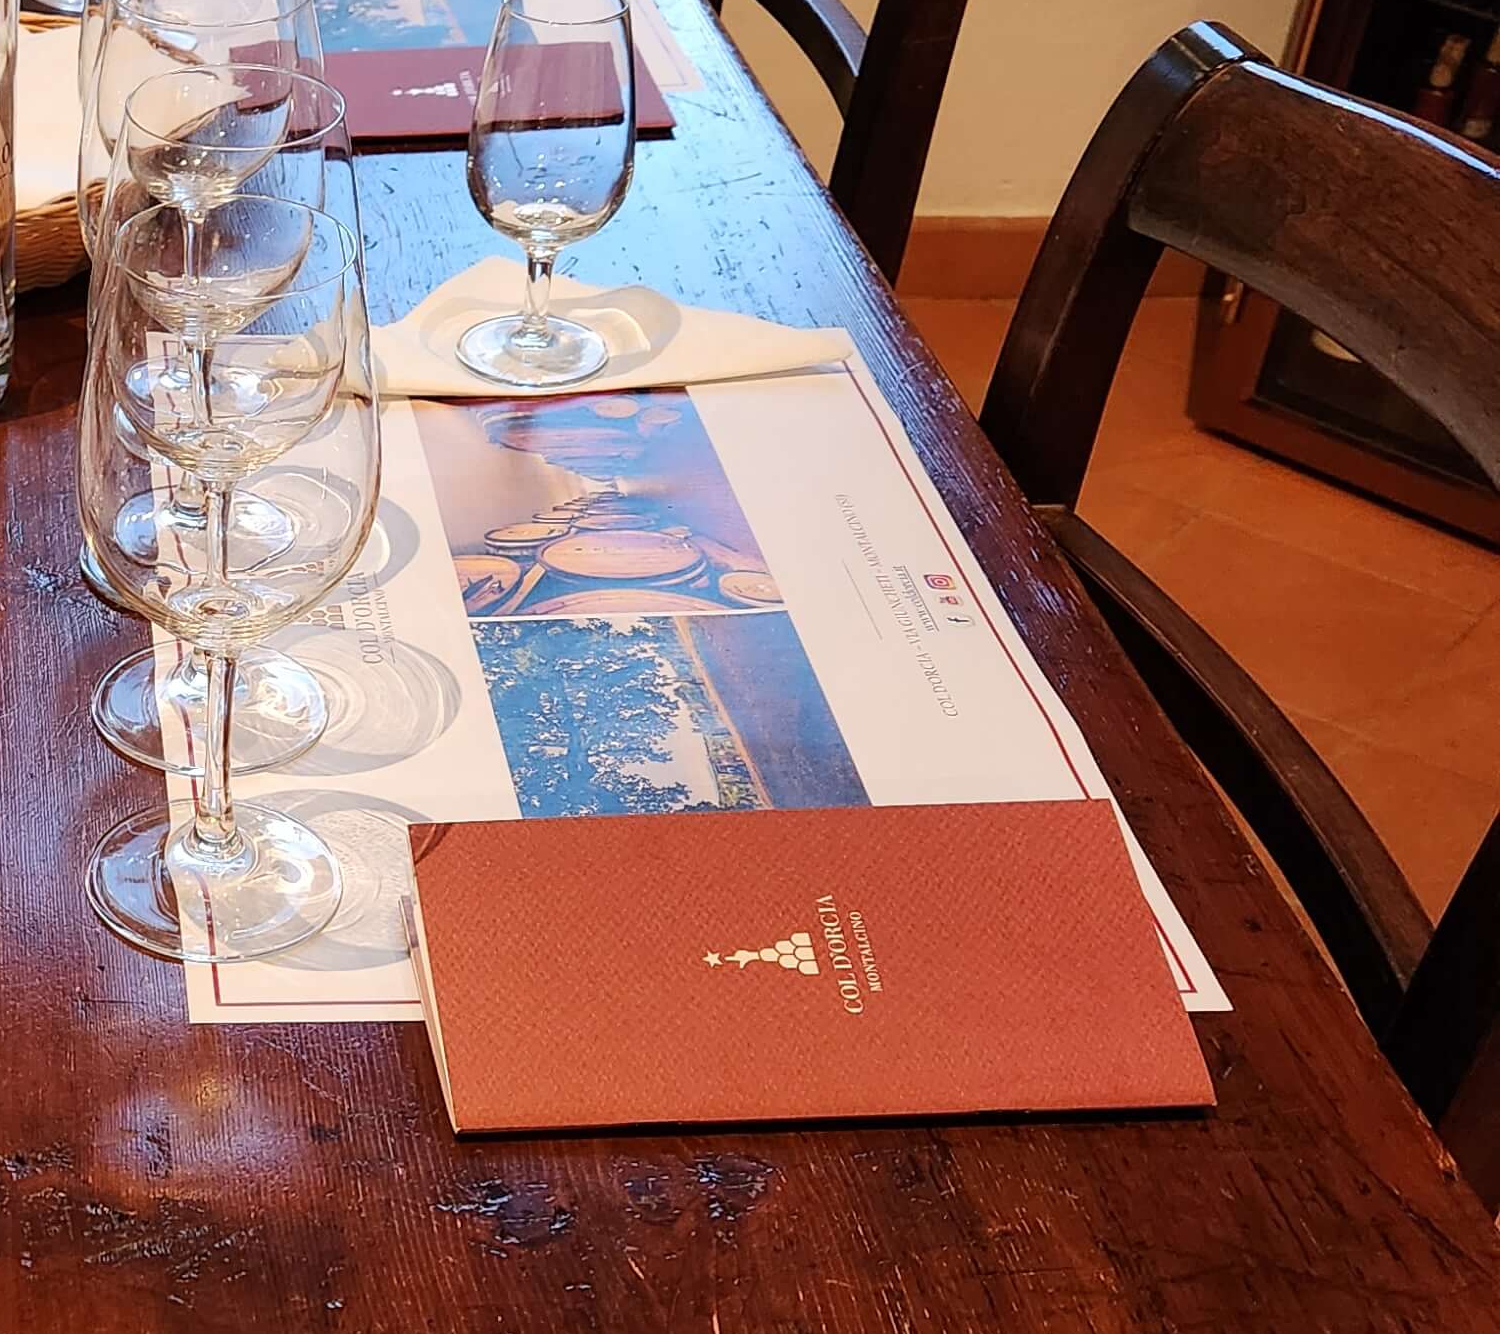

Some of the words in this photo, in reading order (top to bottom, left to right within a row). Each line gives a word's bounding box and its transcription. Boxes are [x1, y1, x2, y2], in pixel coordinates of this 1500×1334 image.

[346, 571, 376, 632] D'ORCIA
[373, 588, 395, 644] MONTALCINO
[358, 635, 384, 665] COL
[937, 693, 959, 717] COL
[815, 894, 853, 970] D'ORCIA
[849, 910, 884, 993] MONTALCINO
[837, 972, 864, 1014] COL
